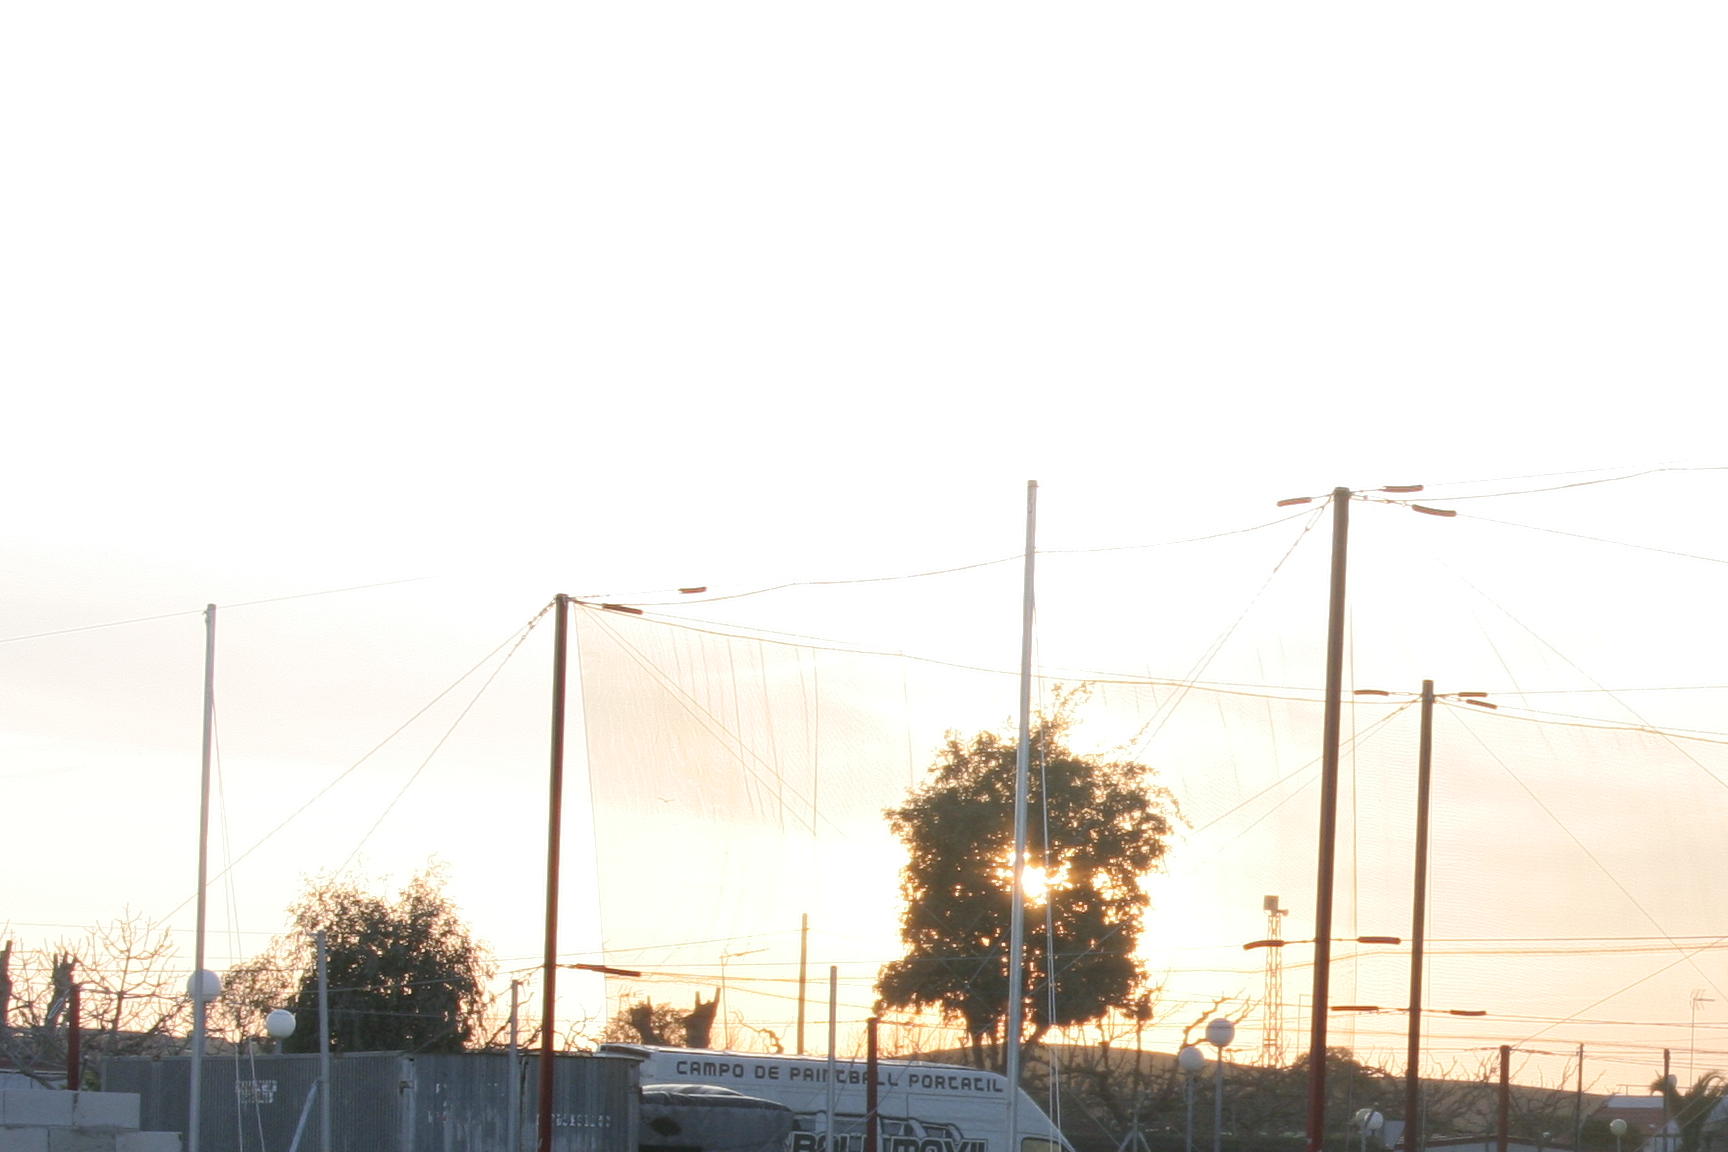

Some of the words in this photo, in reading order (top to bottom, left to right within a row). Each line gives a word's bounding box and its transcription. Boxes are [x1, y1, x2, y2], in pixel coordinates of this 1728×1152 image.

[676, 1060, 744, 1078] CAMPO
[754, 1065, 780, 1080] DE
[908, 1074, 1003, 1093] PORTATIL
